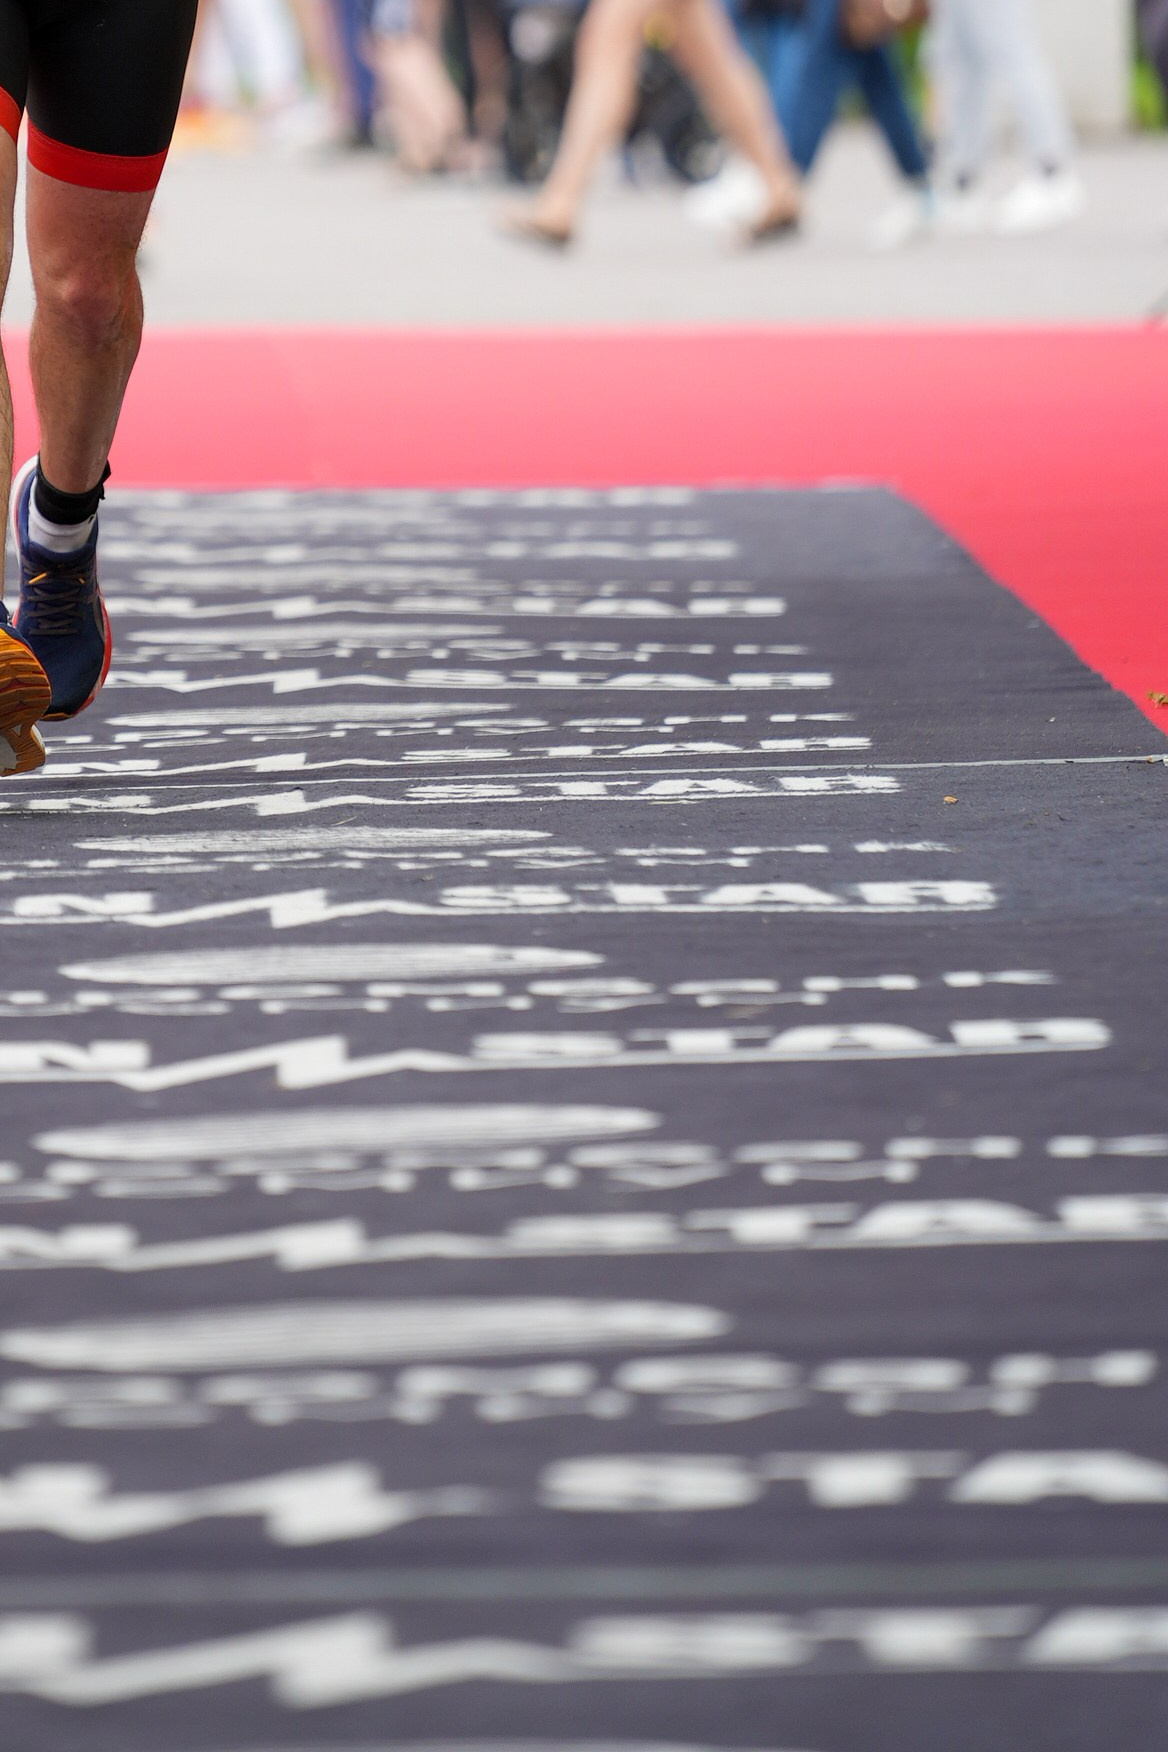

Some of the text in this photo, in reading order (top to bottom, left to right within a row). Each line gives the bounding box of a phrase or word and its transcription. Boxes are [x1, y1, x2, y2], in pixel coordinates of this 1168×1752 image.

[390, 594, 787, 615] STAR
[405, 668, 833, 688] STAR
[401, 736, 873, 761] STAR
[405, 775, 903, 799] STAR
[440, 880, 1000, 908] STAR
[471, 1017, 1112, 1057] STAR
[538, 1448, 1168, 1512] STA
[568, 1605, 1168, 1670] STA
